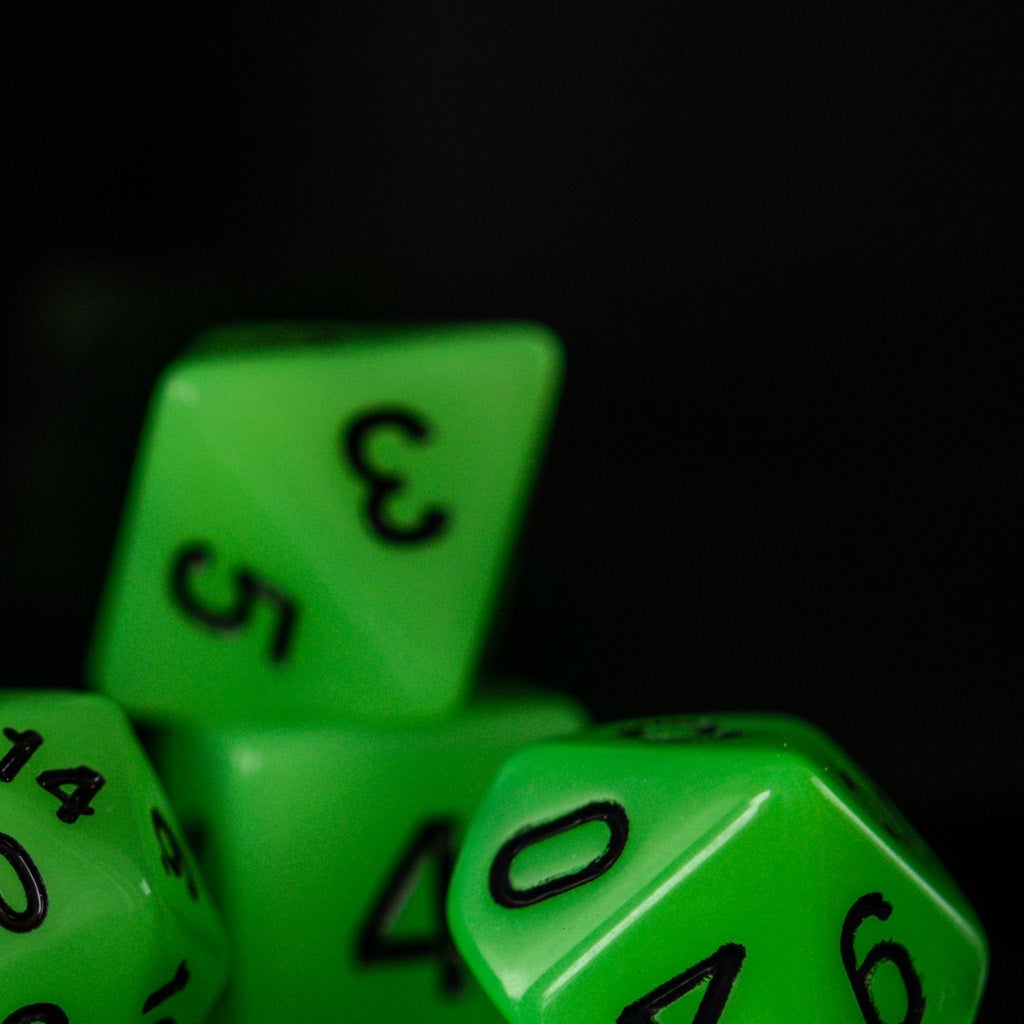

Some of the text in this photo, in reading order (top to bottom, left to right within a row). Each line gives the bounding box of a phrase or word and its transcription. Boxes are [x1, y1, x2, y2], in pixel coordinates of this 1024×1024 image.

[344, 407, 450, 545] 3
[167, 542, 300, 662] 5
[358, 820, 464, 994] 4
[490, 802, 629, 909] 0
